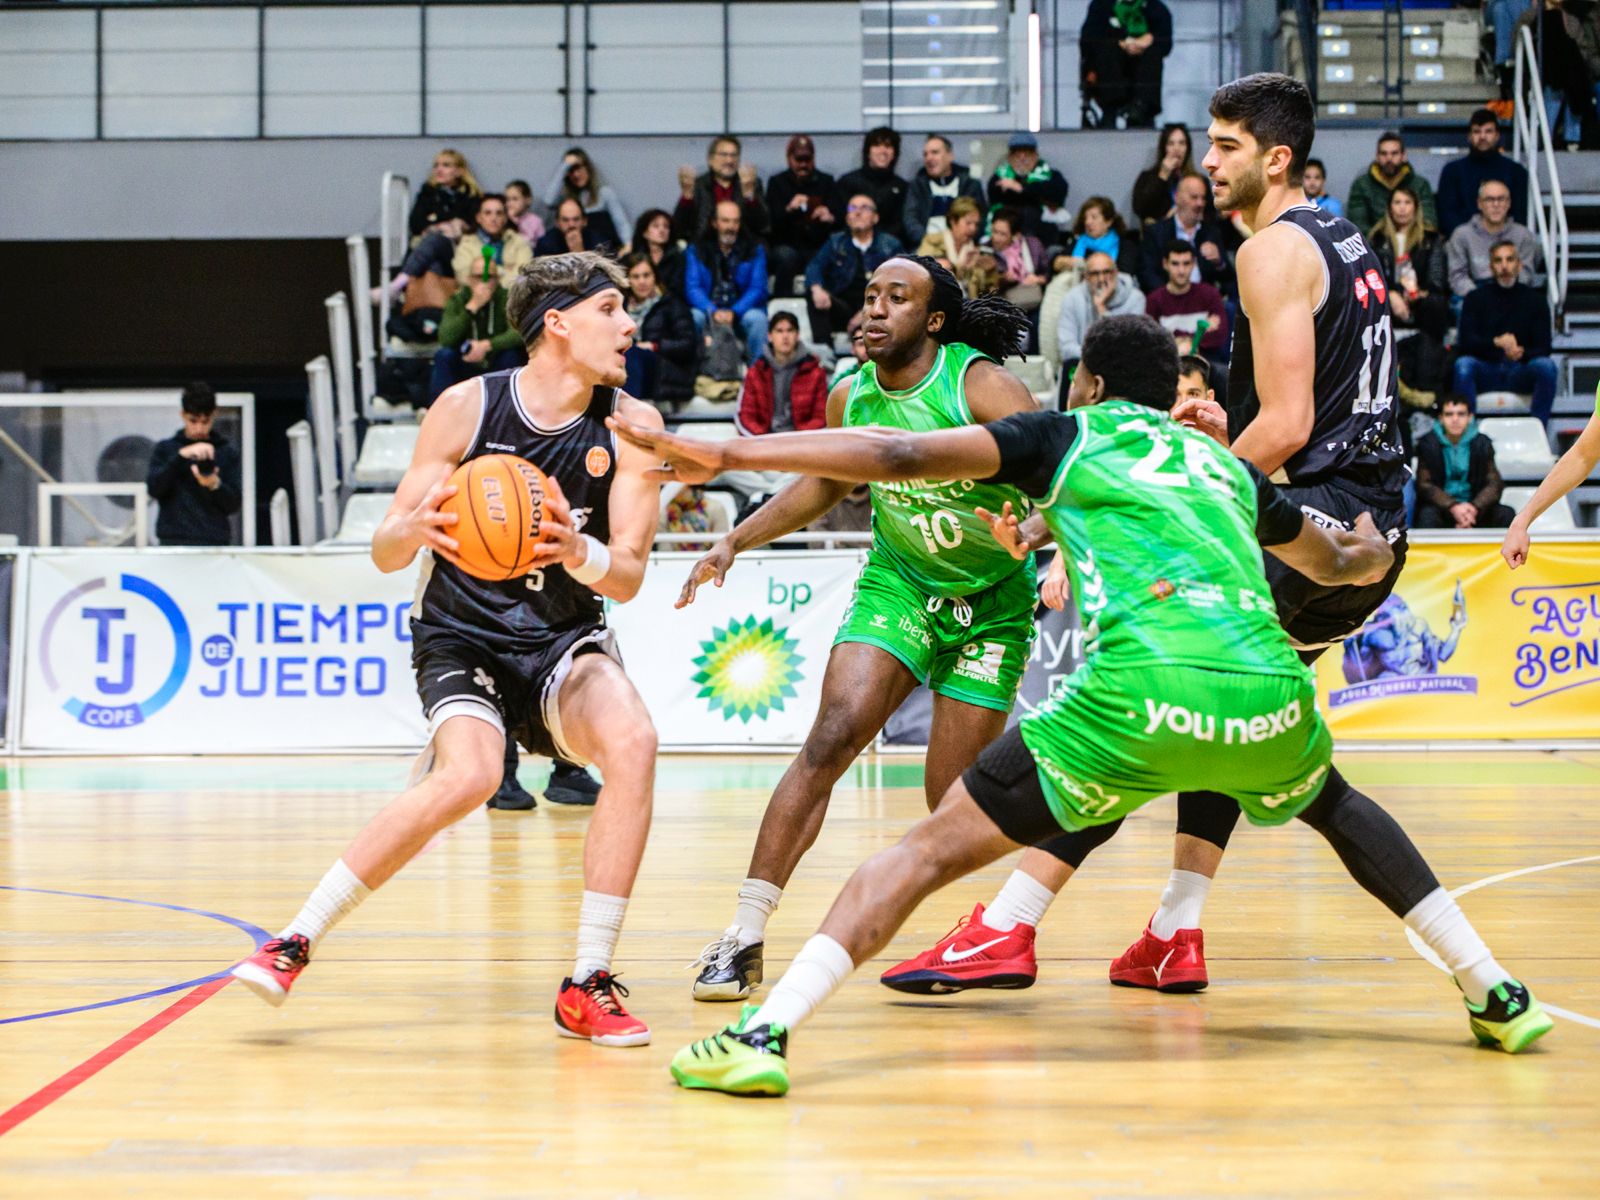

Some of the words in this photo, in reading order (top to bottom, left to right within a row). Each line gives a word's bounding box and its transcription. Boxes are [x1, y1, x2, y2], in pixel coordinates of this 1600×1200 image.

[909, 509, 963, 554] 10
[767, 576, 812, 613] bp
[203, 642, 230, 659] DE
[199, 656, 387, 697] JUEGO
[85, 708, 136, 726] COPE
[1144, 698, 1215, 742] you
